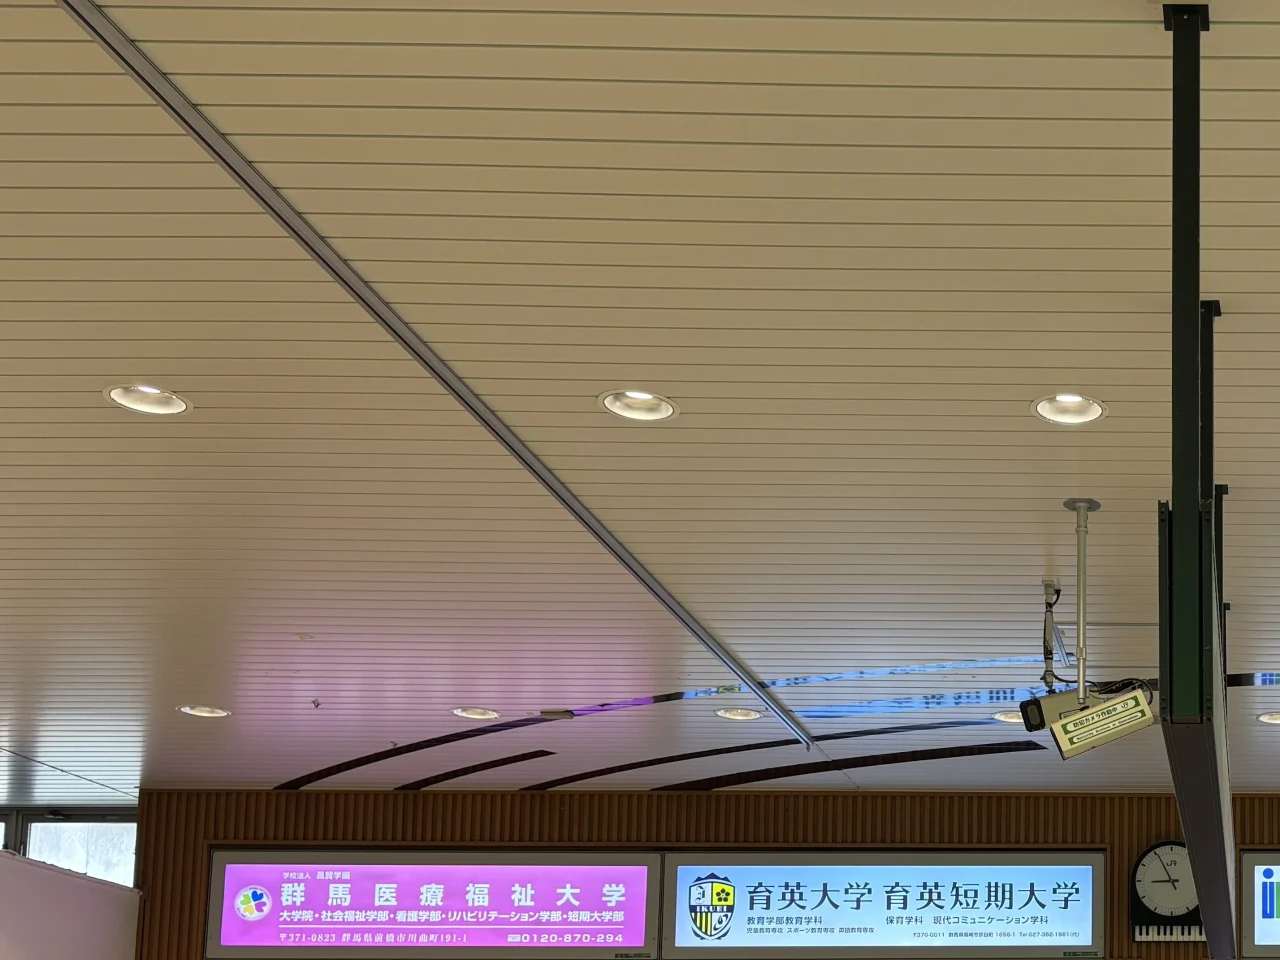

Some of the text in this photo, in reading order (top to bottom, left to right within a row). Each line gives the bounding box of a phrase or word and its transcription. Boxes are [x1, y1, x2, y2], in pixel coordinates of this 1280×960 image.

[280, 882, 626, 906] 群馬医療福祉大学
[746, 881, 1080, 911] 育英大学 育英短期大学
[746, 916, 822, 926] 教育学部教育学科
[886, 916, 1048, 925] 保育学科 現代コミュニケーション学科
[522, 934, 624, 942] 0120-870-294
